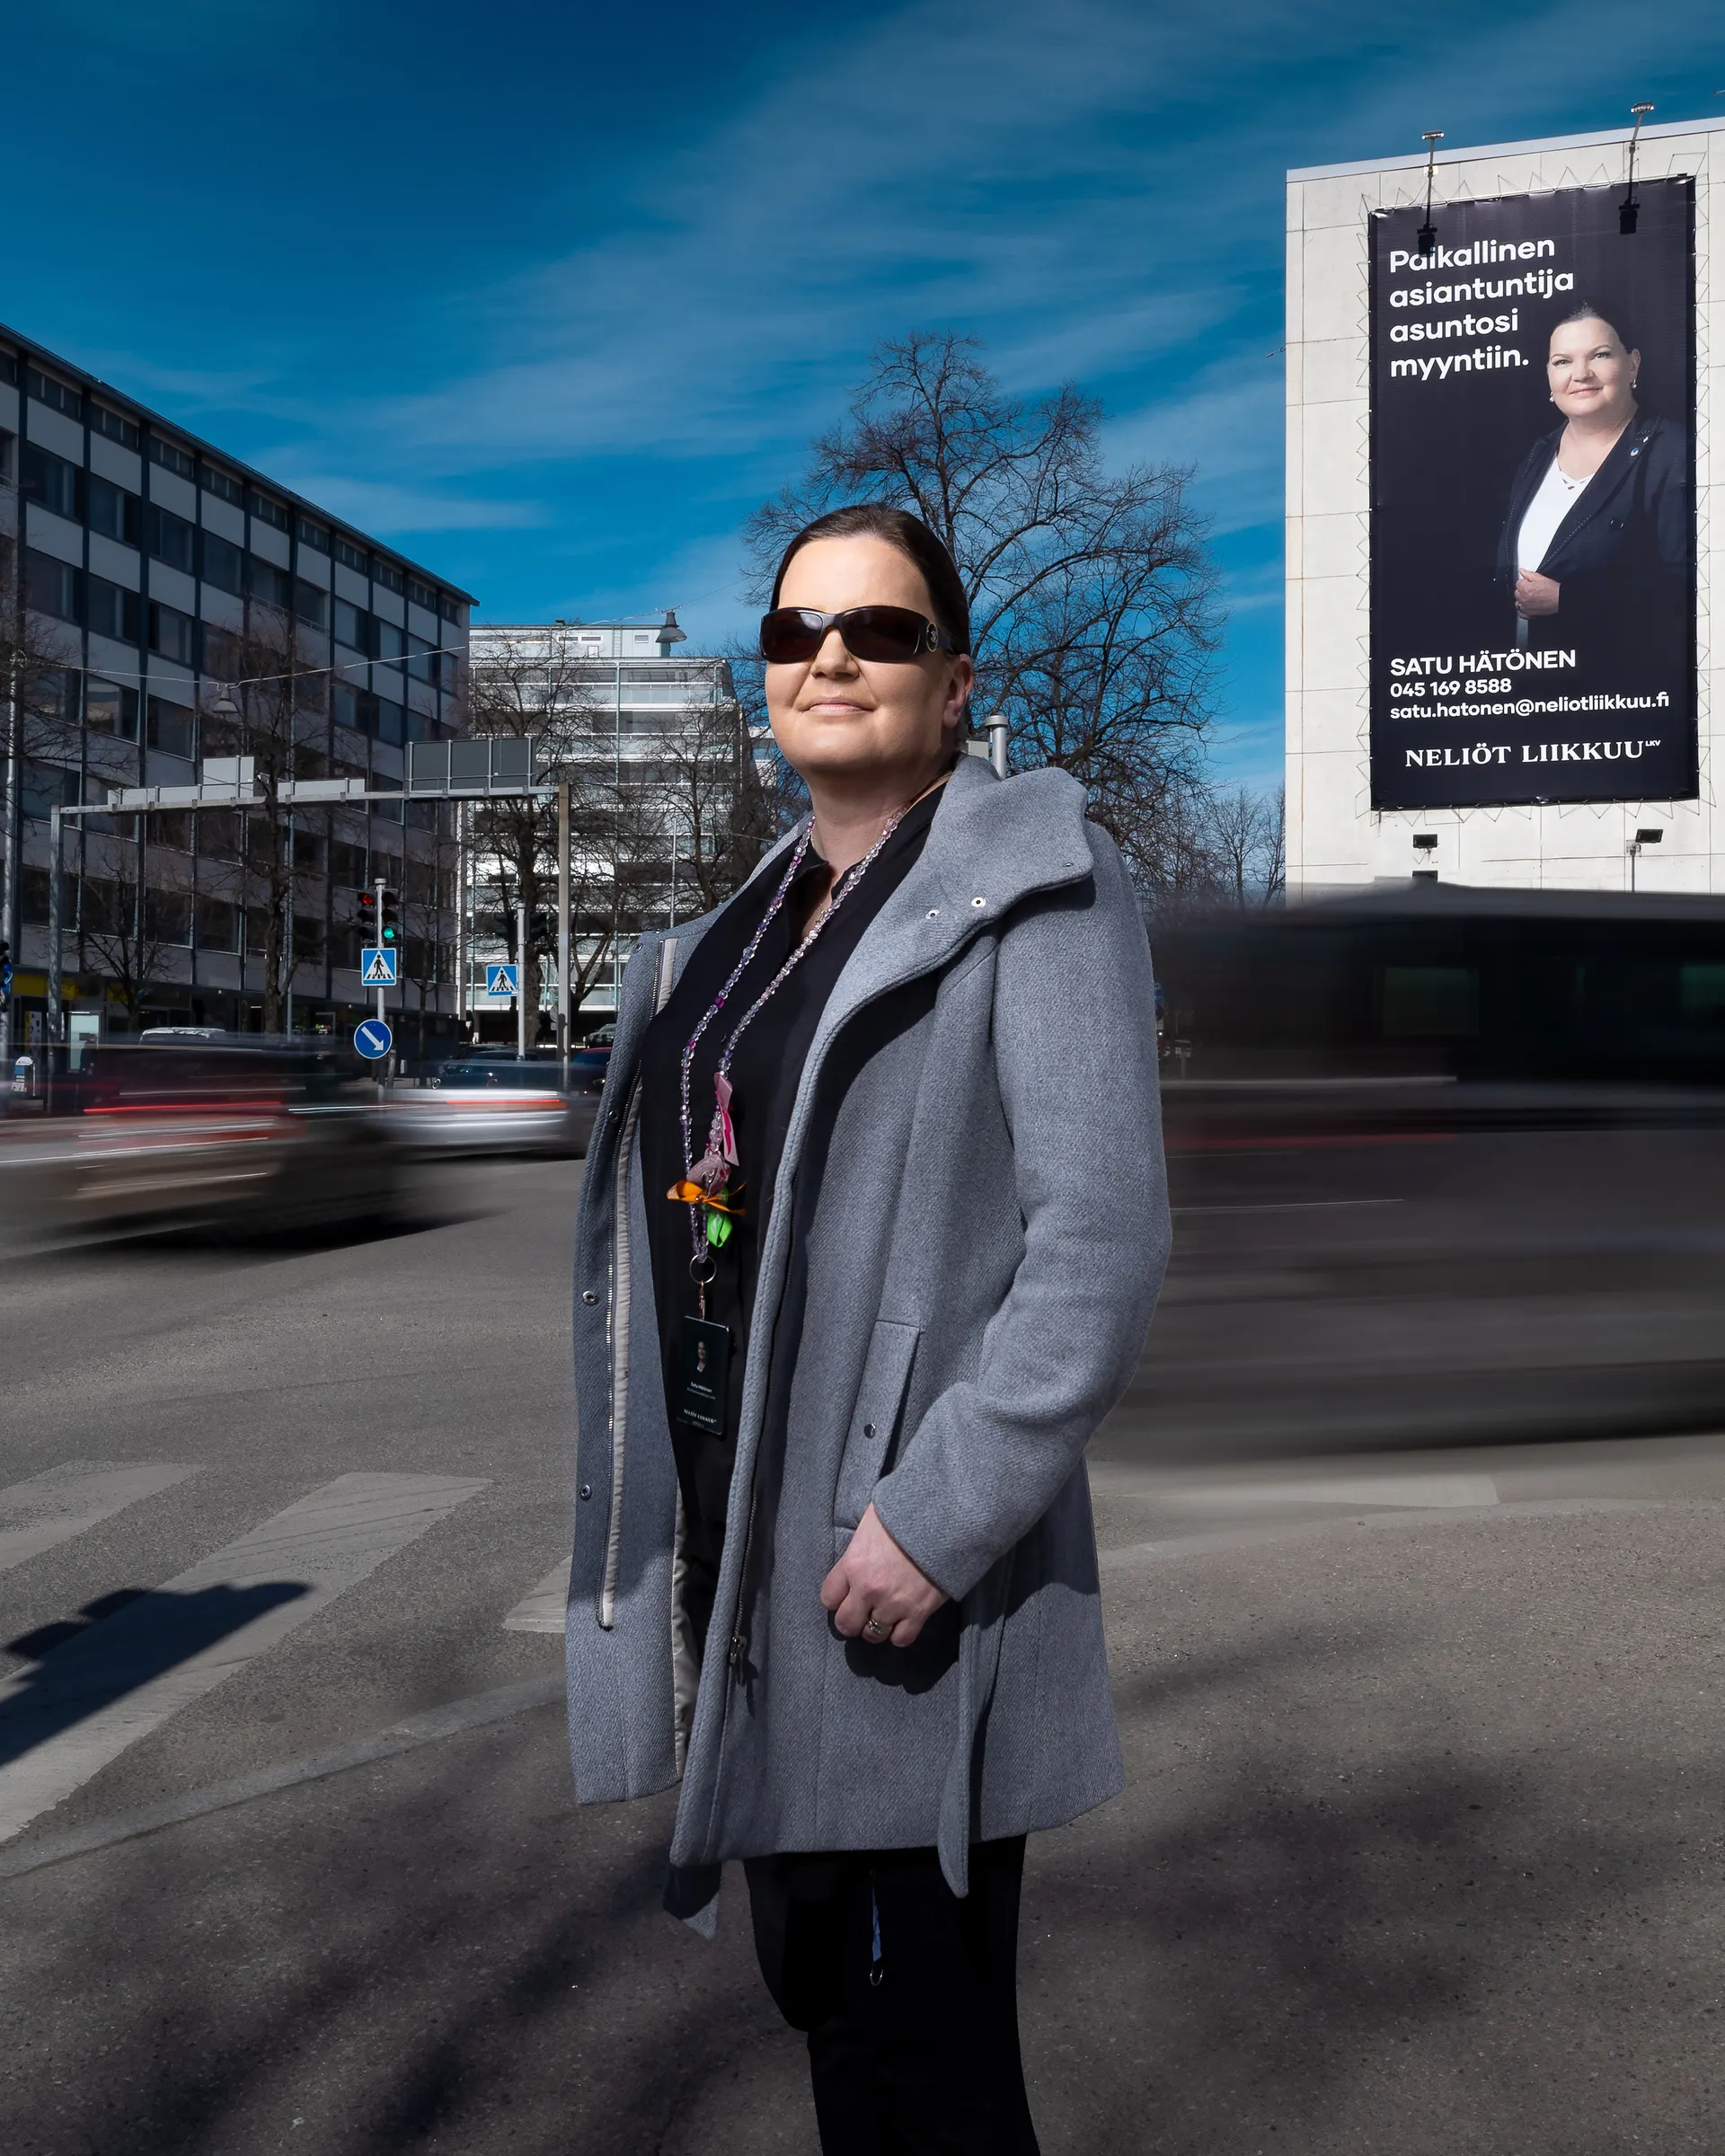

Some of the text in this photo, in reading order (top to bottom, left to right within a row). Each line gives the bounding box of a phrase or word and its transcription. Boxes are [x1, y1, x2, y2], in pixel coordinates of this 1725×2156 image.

[1390, 239, 1555, 273] Paikallinen
[1390, 269, 1574, 308] asiantuntija
[1390, 308, 1518, 342] asuntosi
[1390, 345, 1529, 381] myyntiin.
[1390, 649, 1576, 676] SATU HÄTÖNEN
[1390, 678, 1512, 698] 045 169 8588
[1390, 692, 1669, 720] satu.hatonen@neliotliikkuu.fi
[1405, 743, 1512, 767] NELIÖT
[1522, 740, 1644, 764] LIIKKUU
